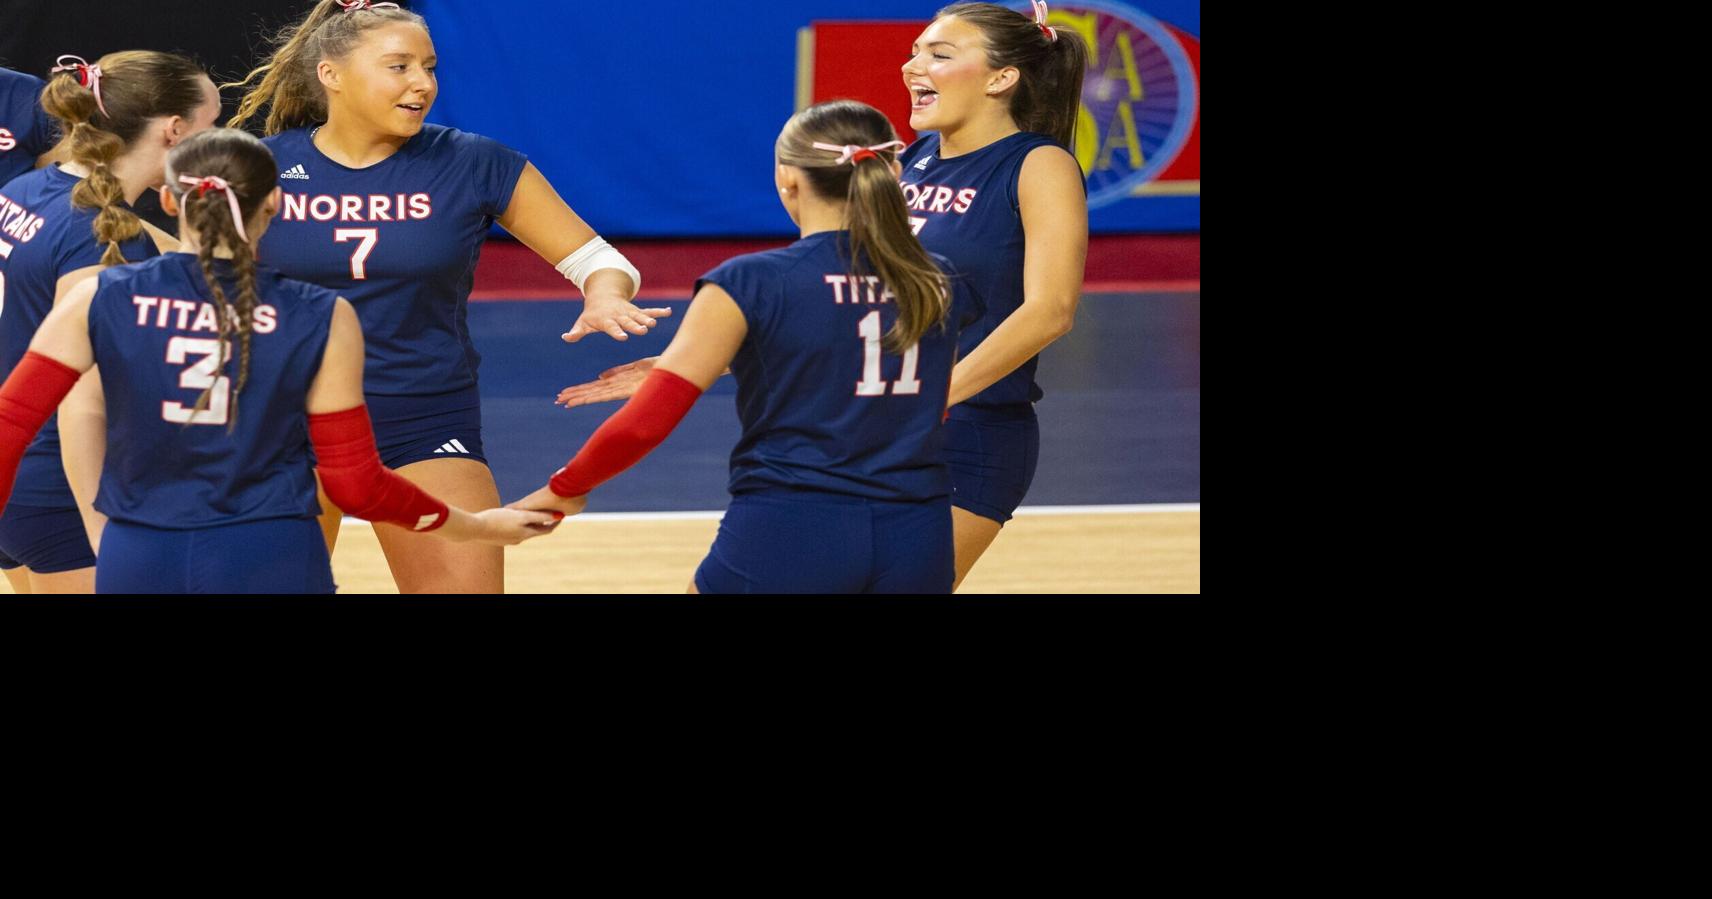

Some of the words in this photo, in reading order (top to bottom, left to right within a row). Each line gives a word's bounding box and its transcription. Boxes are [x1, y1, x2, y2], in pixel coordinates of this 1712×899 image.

[281, 192, 432, 222] NORRIS
[899, 181, 977, 214] ORRS
[334, 227, 379, 280] 7
[854, 310, 922, 396] 11
[161, 335, 233, 426] 3
